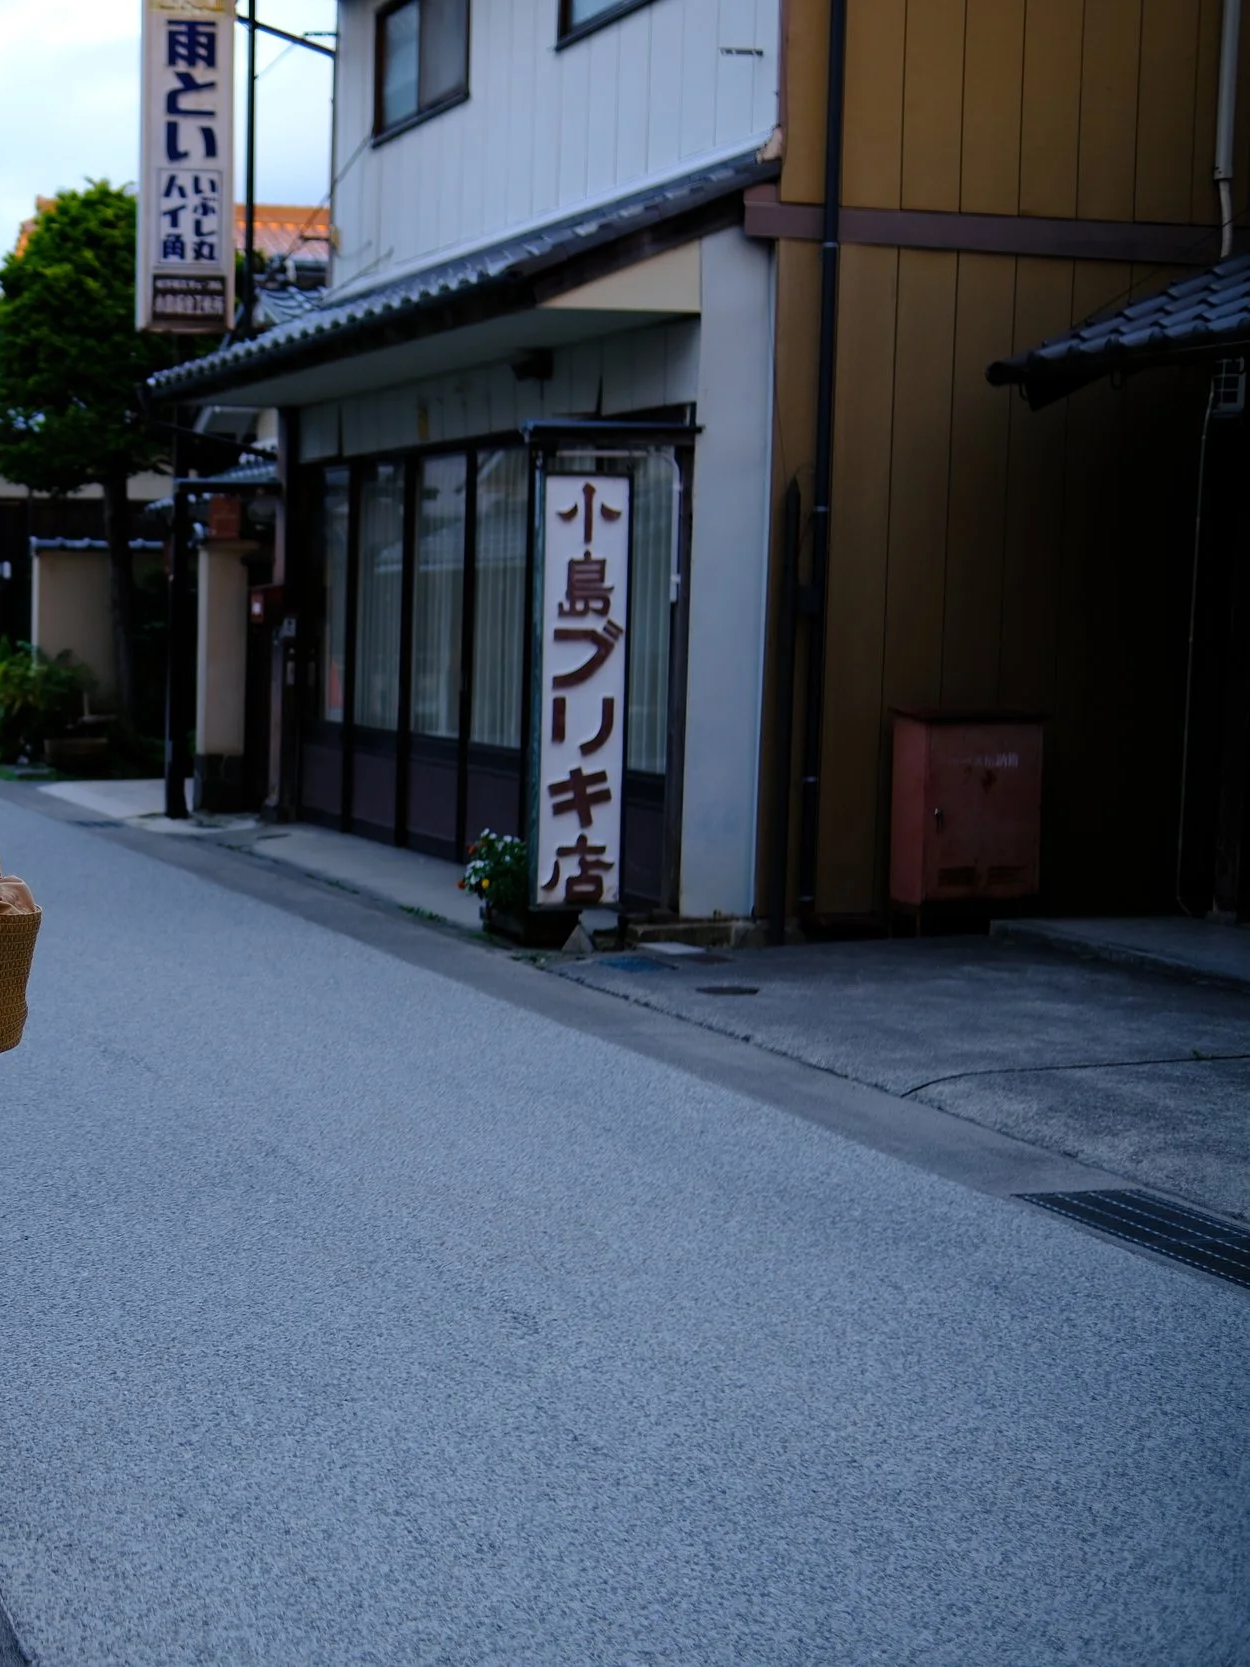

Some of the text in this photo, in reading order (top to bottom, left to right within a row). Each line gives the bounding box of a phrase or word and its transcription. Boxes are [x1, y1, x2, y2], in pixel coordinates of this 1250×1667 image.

[166, 19, 217, 162] 雨とい
[162, 174, 187, 260] ハイ角
[192, 174, 217, 261] いぶし丸
[541, 481, 623, 902] 小島ブリキ店
